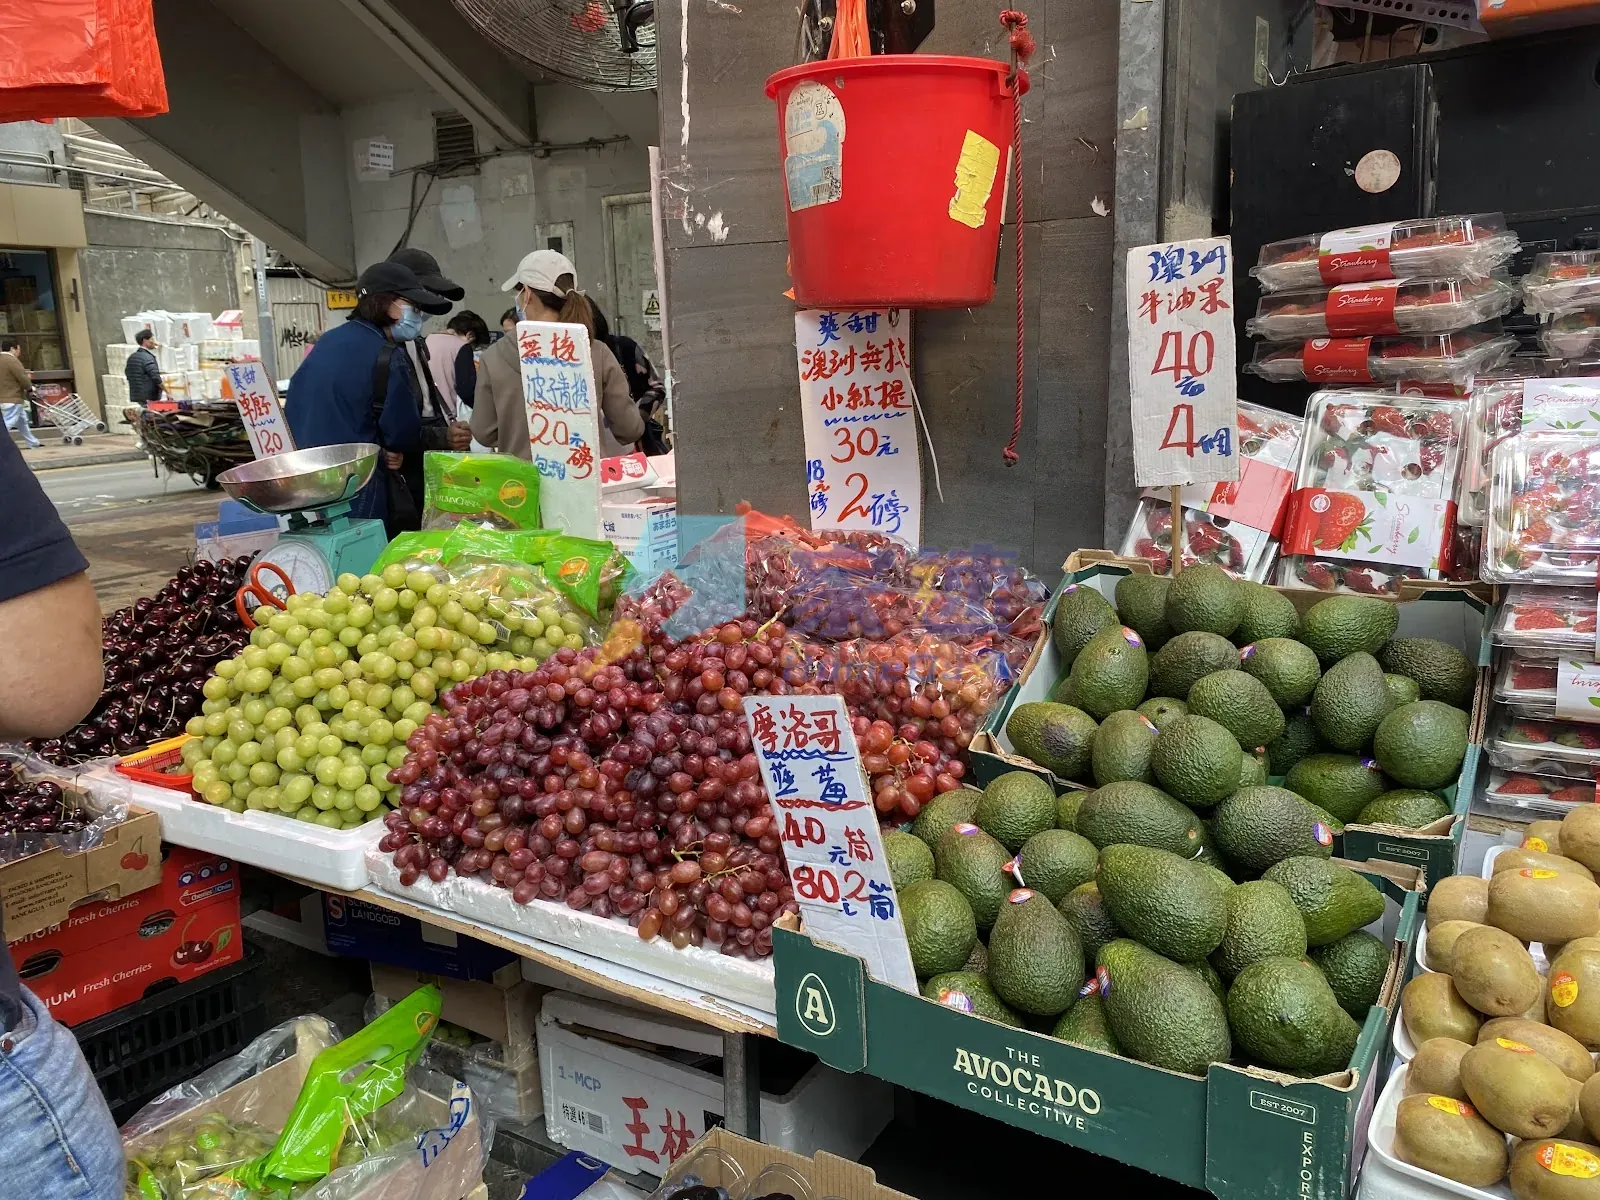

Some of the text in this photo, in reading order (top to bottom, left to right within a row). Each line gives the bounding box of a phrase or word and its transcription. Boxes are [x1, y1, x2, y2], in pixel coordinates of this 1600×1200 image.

[1148, 244, 1227, 284] 澳洲
[1330, 256, 1379, 272] Strawberry
[1138, 277, 1230, 325] 牛油果
[1336, 293, 1385, 308] Strawberry
[817, 311, 881, 346] 爽甜
[519, 330, 580, 362] 無核
[1151, 330, 1215, 382] 40
[1313, 364, 1358, 377] Strawberry
[821, 379, 912, 411] 小紅提
[254, 430, 283, 455] 120
[652, 518, 677, 533] あまおう
[1386, 502, 1410, 555] Strawberry
[751, 703, 842, 754] 摩洛哥
[770, 761, 848, 805] 藍莓
[11, 905, 45, 920] RANCAGUA
[49, 897, 66, 907] CHILE
[69, 911, 97, 928] Fresh
[98, 898, 140, 918] Cherries
[352, 908, 400, 926] LANDGOED
[83, 977, 110, 994] Fresh
[112, 962, 153, 983] Cherries
[804, 987, 829, 1025] A
[1005, 1046, 1041, 1068] THE
[557, 1065, 602, 1093] 1-MCP
[953, 1047, 1101, 1115] AVOCADO
[966, 1081, 1086, 1131] COLLECTIVE
[1260, 1098, 1306, 1116] EST 2007
[622, 1096, 695, 1164] 王林
